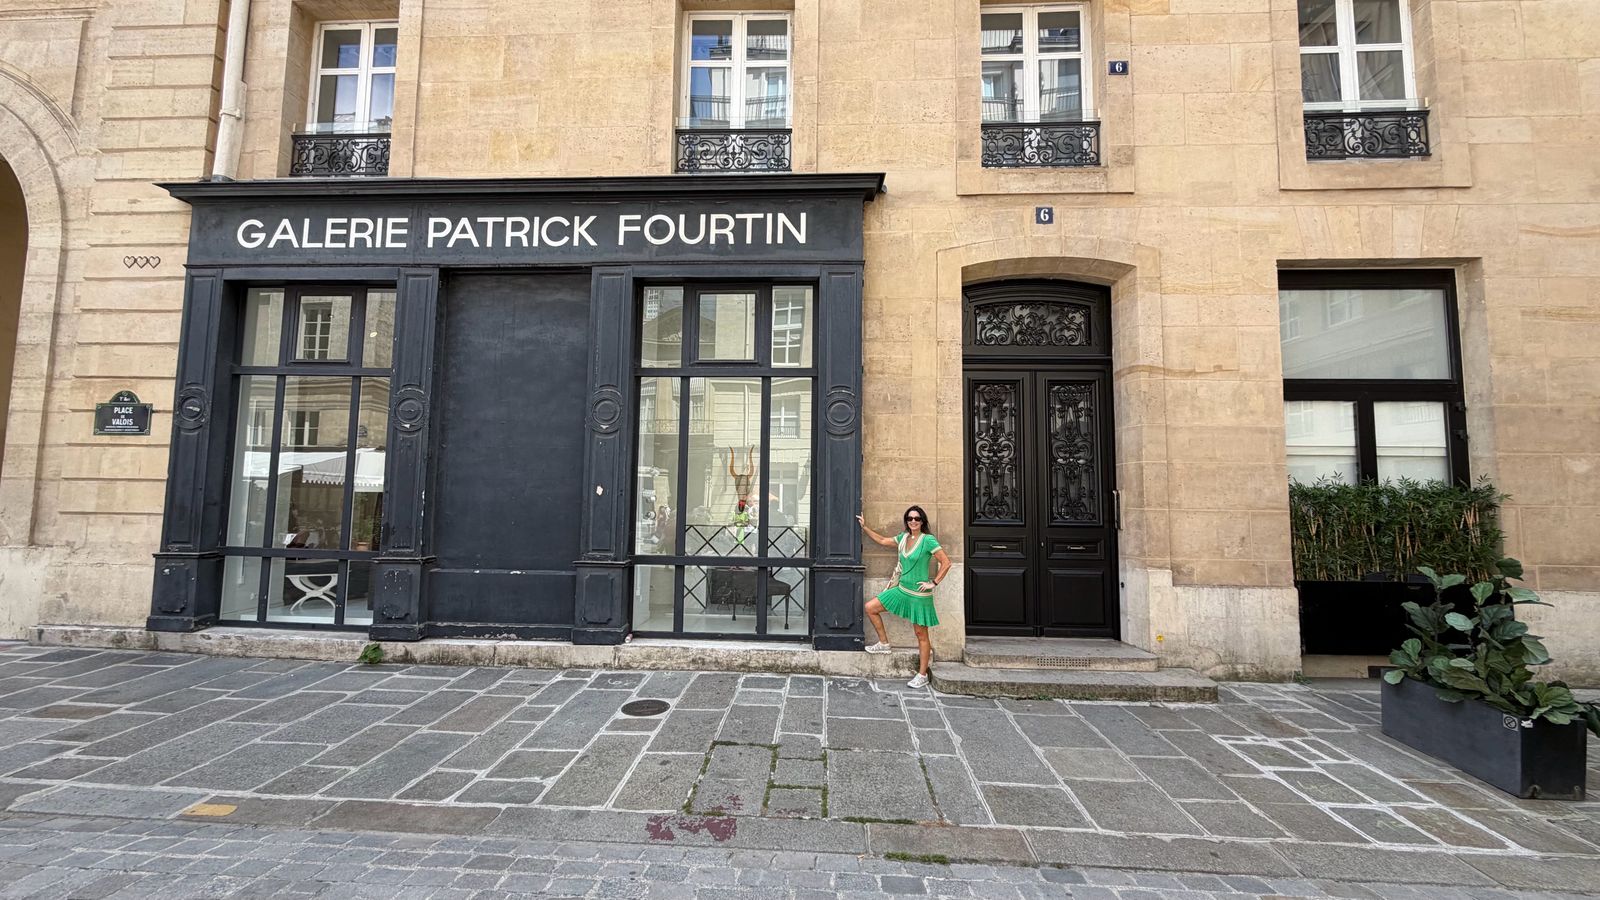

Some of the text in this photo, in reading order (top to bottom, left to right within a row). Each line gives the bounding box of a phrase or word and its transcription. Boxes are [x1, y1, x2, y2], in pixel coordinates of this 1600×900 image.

[1115, 62, 1123, 73] 6
[1040, 208, 1050, 222] 6
[236, 212, 807, 249] GALERIE PATRICK FOURTIN
